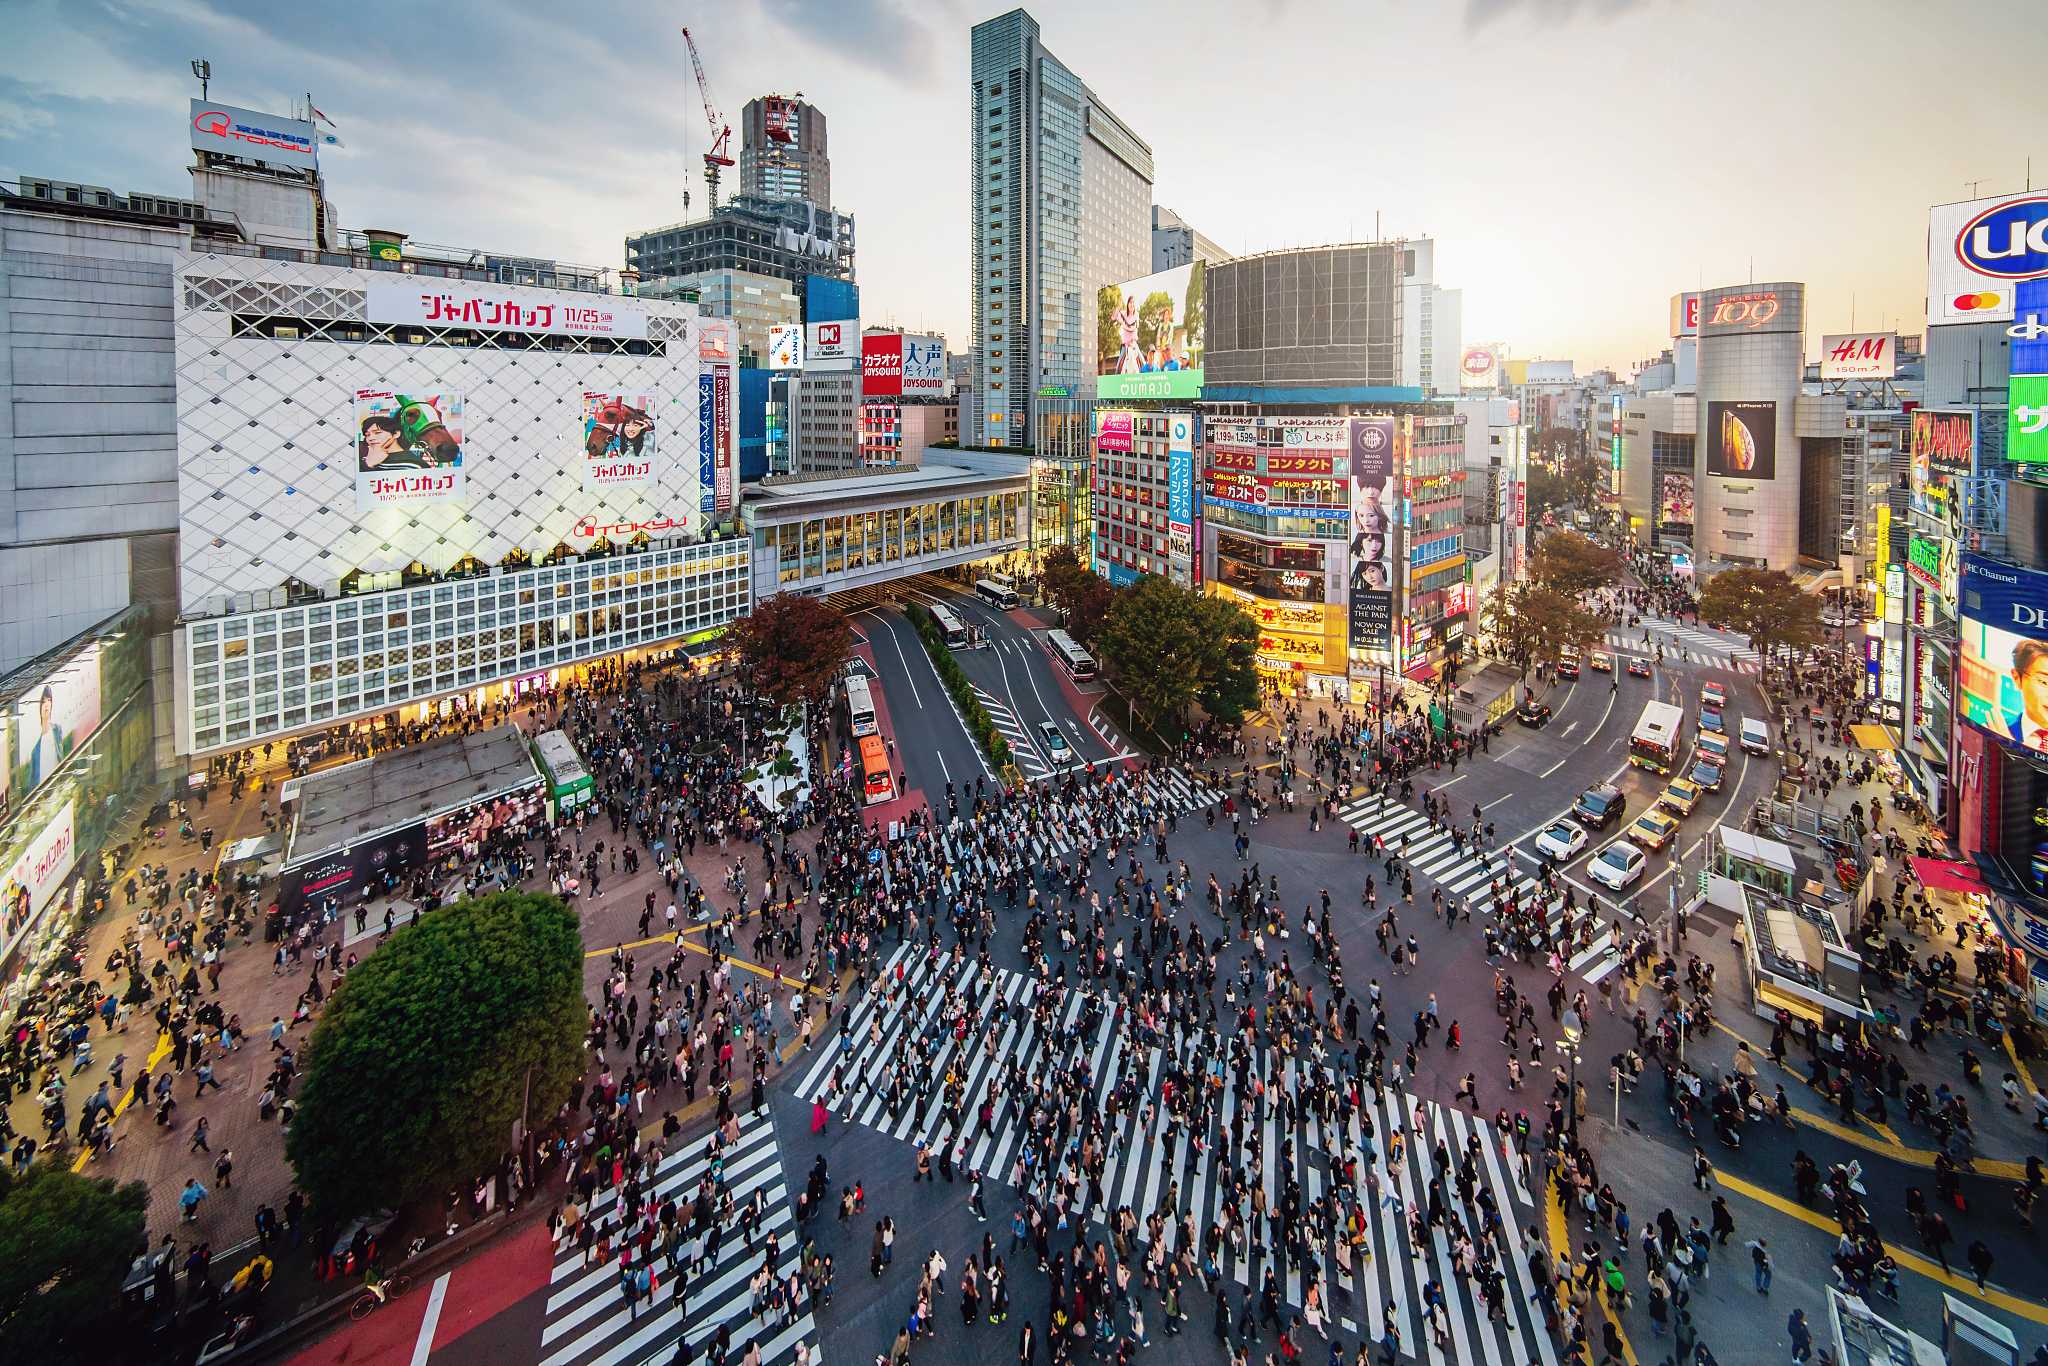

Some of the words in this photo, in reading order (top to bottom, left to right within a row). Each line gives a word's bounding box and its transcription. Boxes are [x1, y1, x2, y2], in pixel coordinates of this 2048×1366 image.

[228, 131, 312, 153] TOKYU
[1720, 293, 1777, 303] SHIBUYA
[421, 295, 556, 328] ジャパンカップ
[564, 307, 598, 323] 11/25
[601, 312, 613, 321] SUN
[1707, 299, 1778, 328] 109
[904, 342, 942, 364] 大声
[1830, 337, 1886, 362] H&M
[864, 353, 901, 367] カラオケ
[864, 366, 901, 377] JOYSOUND
[903, 378, 943, 389] JOYSOUND
[592, 462, 651, 478] ジャパンカップ
[1269, 458, 1331, 471] コンタクト
[370, 474, 456, 494] ジャパンカップ
[1171, 457, 1181, 517] アイシティ
[1205, 482, 1215, 491] 7F
[1237, 475, 1258, 486] ガスト
[1311, 479, 1341, 490] ガスト
[1227, 485, 1252, 500] ガスト
[1293, 509, 1348, 519] 英会話イーオン
[595, 516, 687, 536] TOKYU
[1979, 567, 2017, 584] Channel
[1355, 603, 1388, 612] AGAINST
[1371, 611, 1389, 619] PAIN
